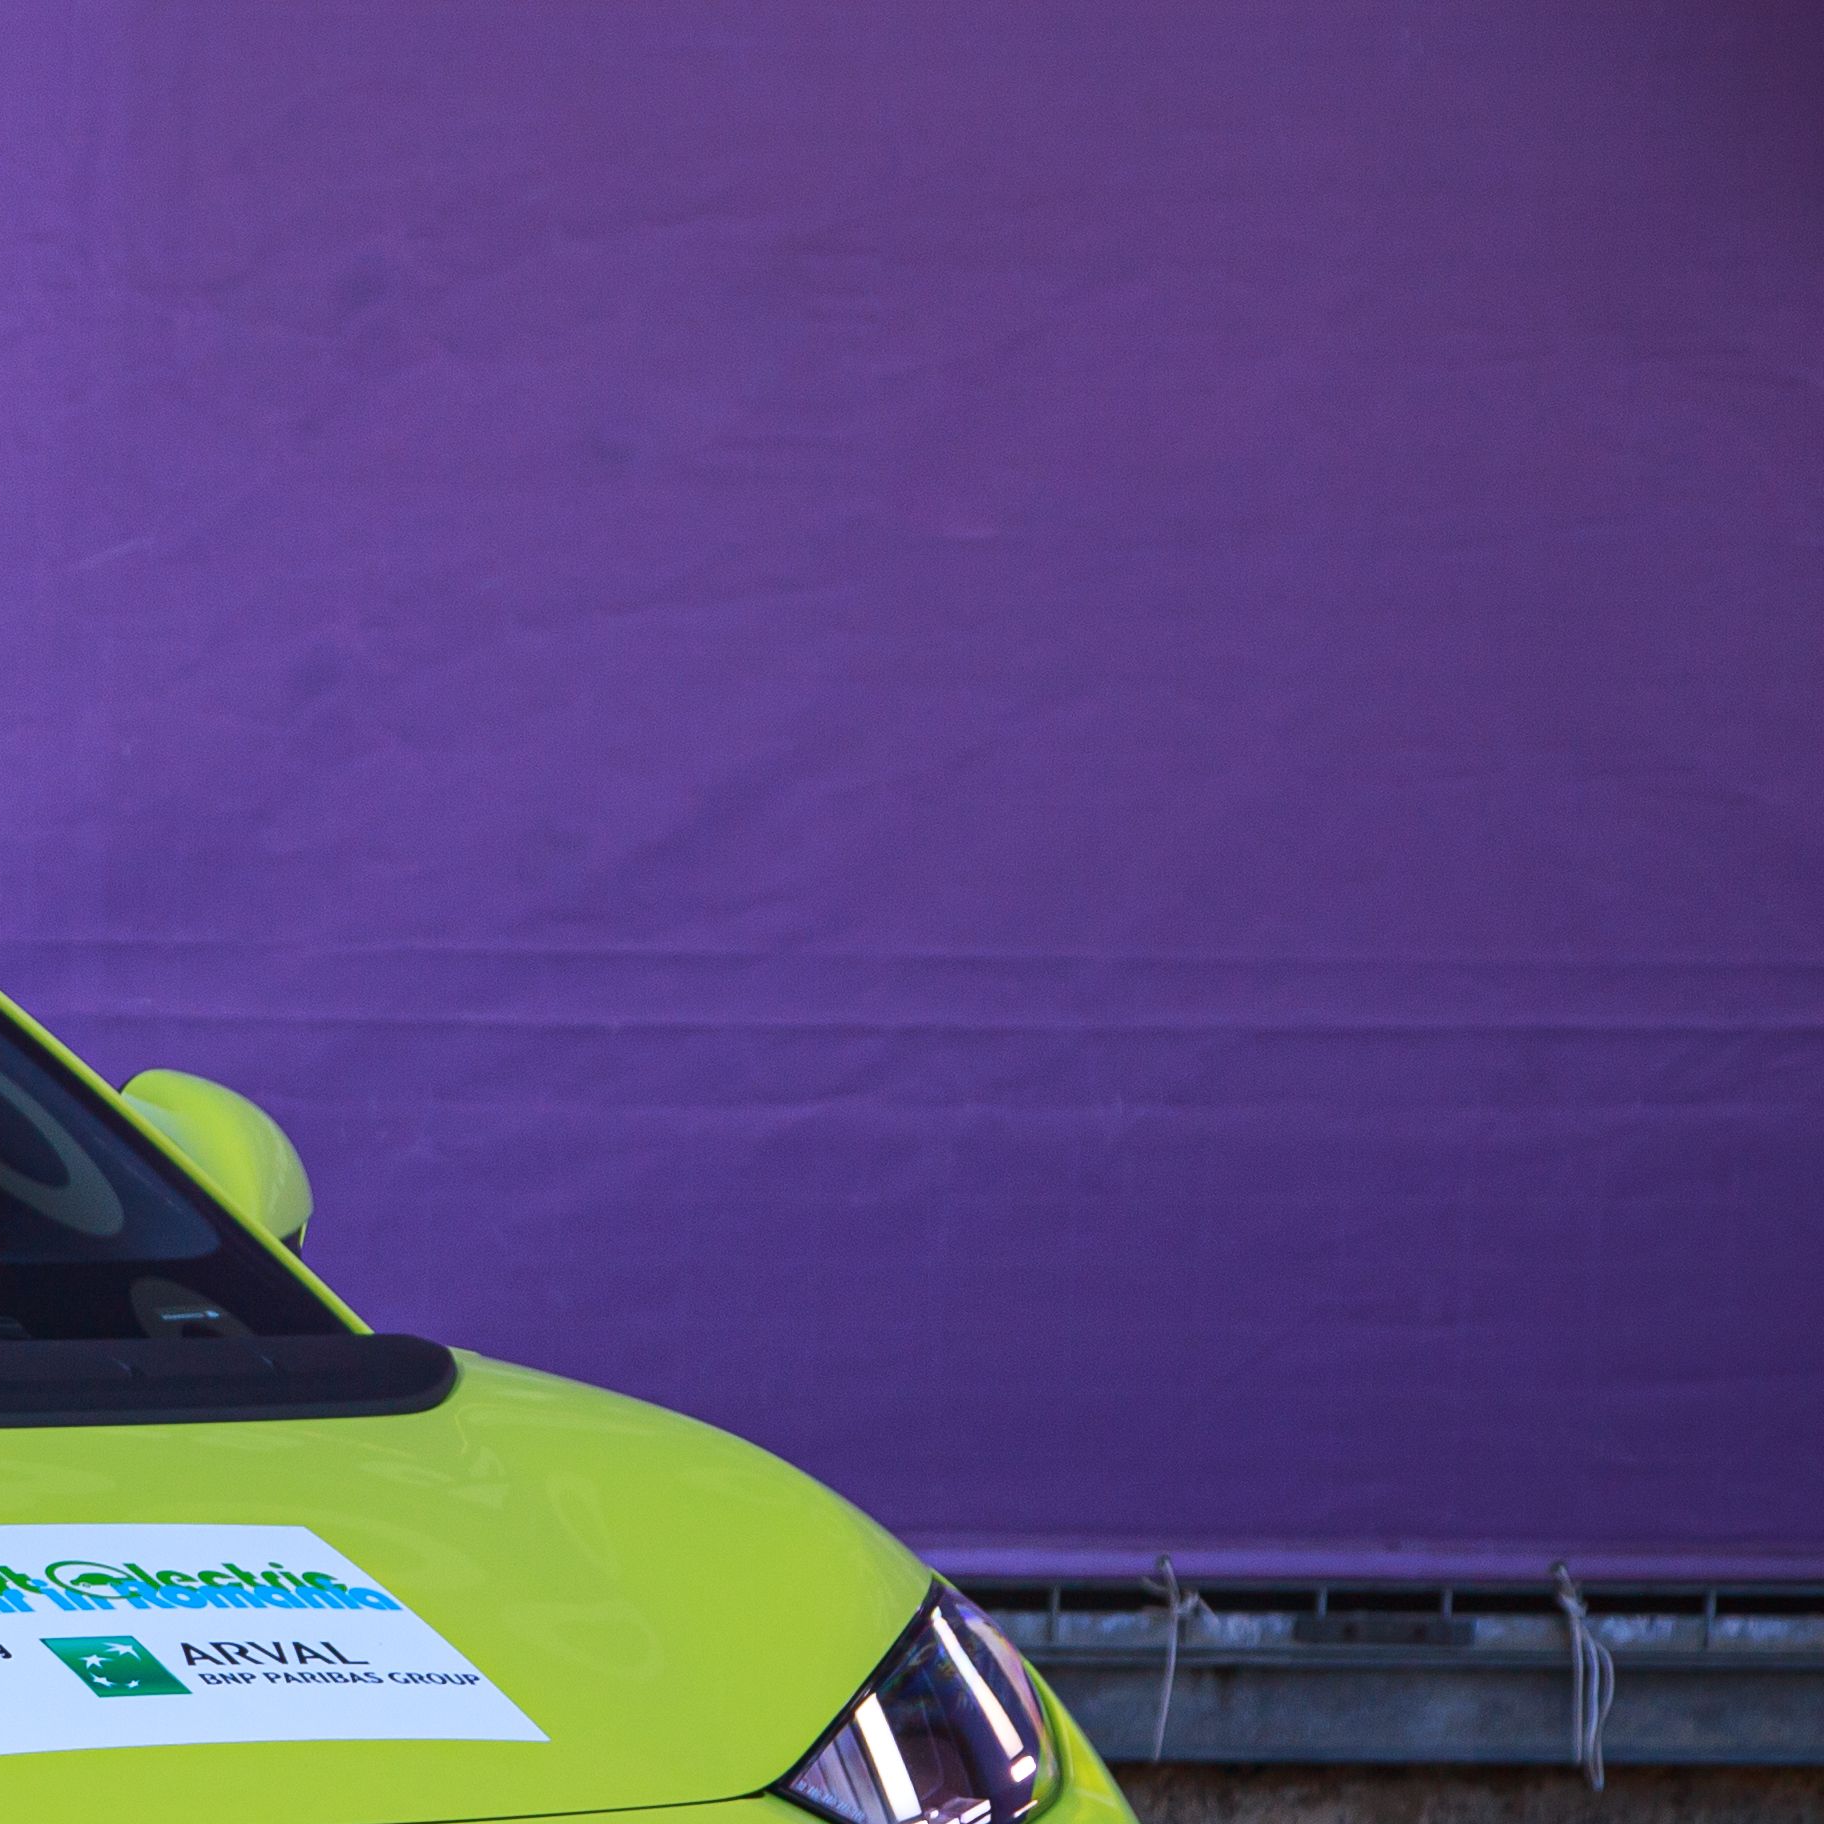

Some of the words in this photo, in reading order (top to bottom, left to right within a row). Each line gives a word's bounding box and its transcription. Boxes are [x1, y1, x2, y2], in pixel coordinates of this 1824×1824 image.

[28, 1578, 112, 1612] in
[107, 1577, 403, 1612] Romania
[179, 1640, 370, 1667] ARVAL
[197, 1673, 257, 1686] BNP
[265, 1671, 384, 1686] PARIBAS
[387, 1672, 481, 1687] GROUP
